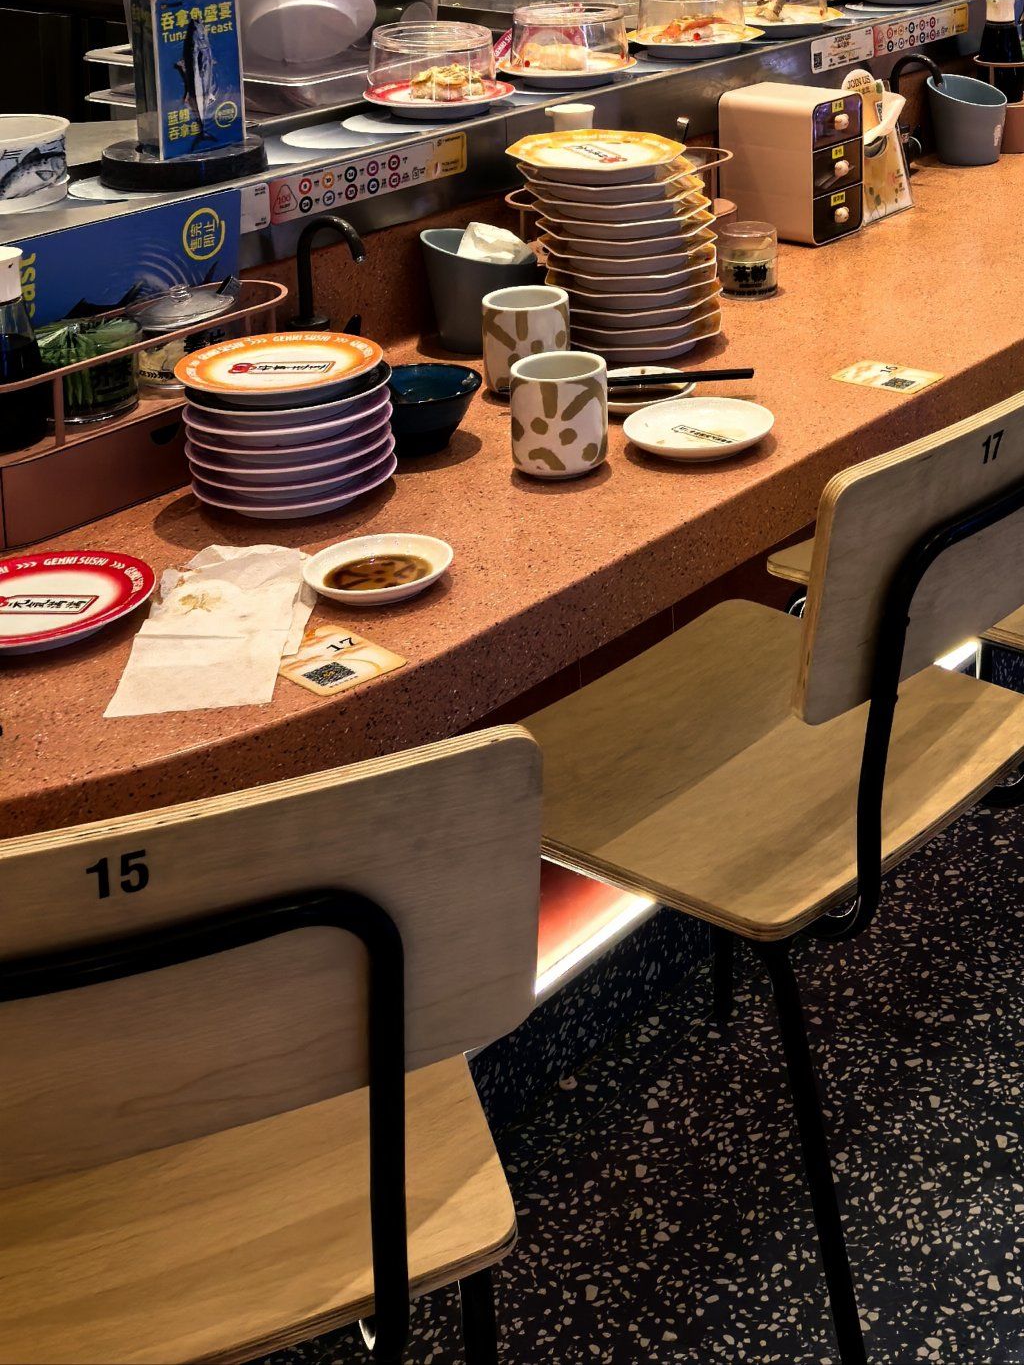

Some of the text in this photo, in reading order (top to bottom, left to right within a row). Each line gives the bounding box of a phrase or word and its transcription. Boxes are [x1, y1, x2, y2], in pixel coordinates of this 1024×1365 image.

[847, 75, 871, 89] JOIN US
[189, 221, 203, 252] 售完
[203, 218, 217, 248] 即止
[272, 334, 331, 342] GENKI SUSHI
[880, 365, 898, 374] 16
[981, 429, 1004, 464] 17
[44, 556, 109, 566] GENKI SUSHI
[326, 637, 357, 652] 17
[86, 849, 150, 900] 15
